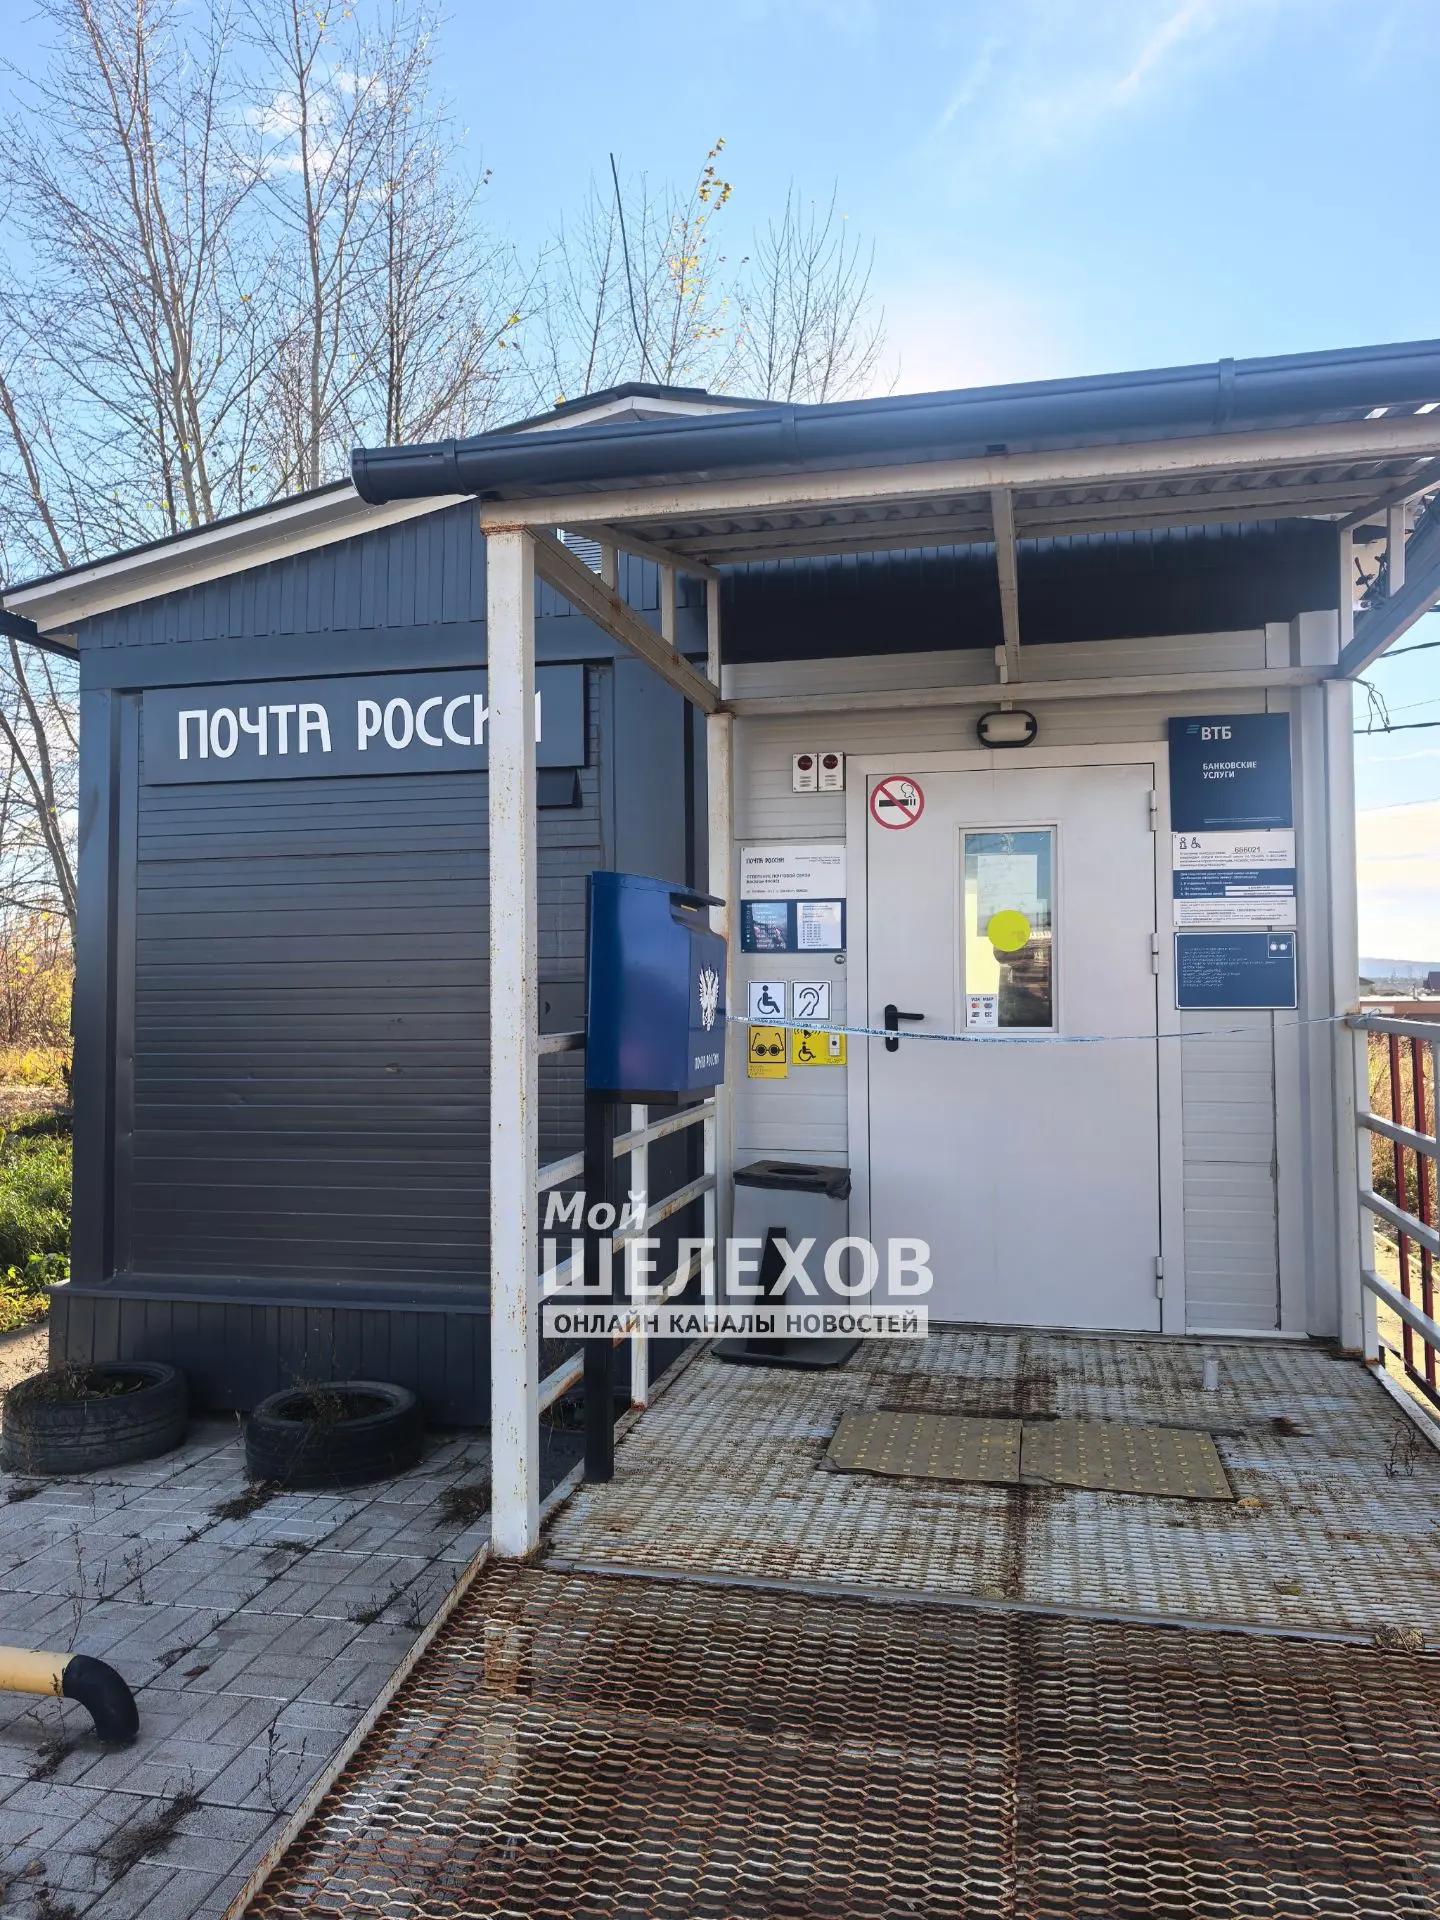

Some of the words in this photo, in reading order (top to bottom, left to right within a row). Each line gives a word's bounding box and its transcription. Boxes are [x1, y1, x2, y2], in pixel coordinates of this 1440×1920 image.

[179, 703, 332, 760] ПОЧТА
[357, 690, 542, 751] РОССИ
[1201, 725, 1232, 741] ВТБ
[1203, 760, 1257, 770] БАНКОВСКИЕ
[1203, 771, 1235, 779] УСЛУГИ
